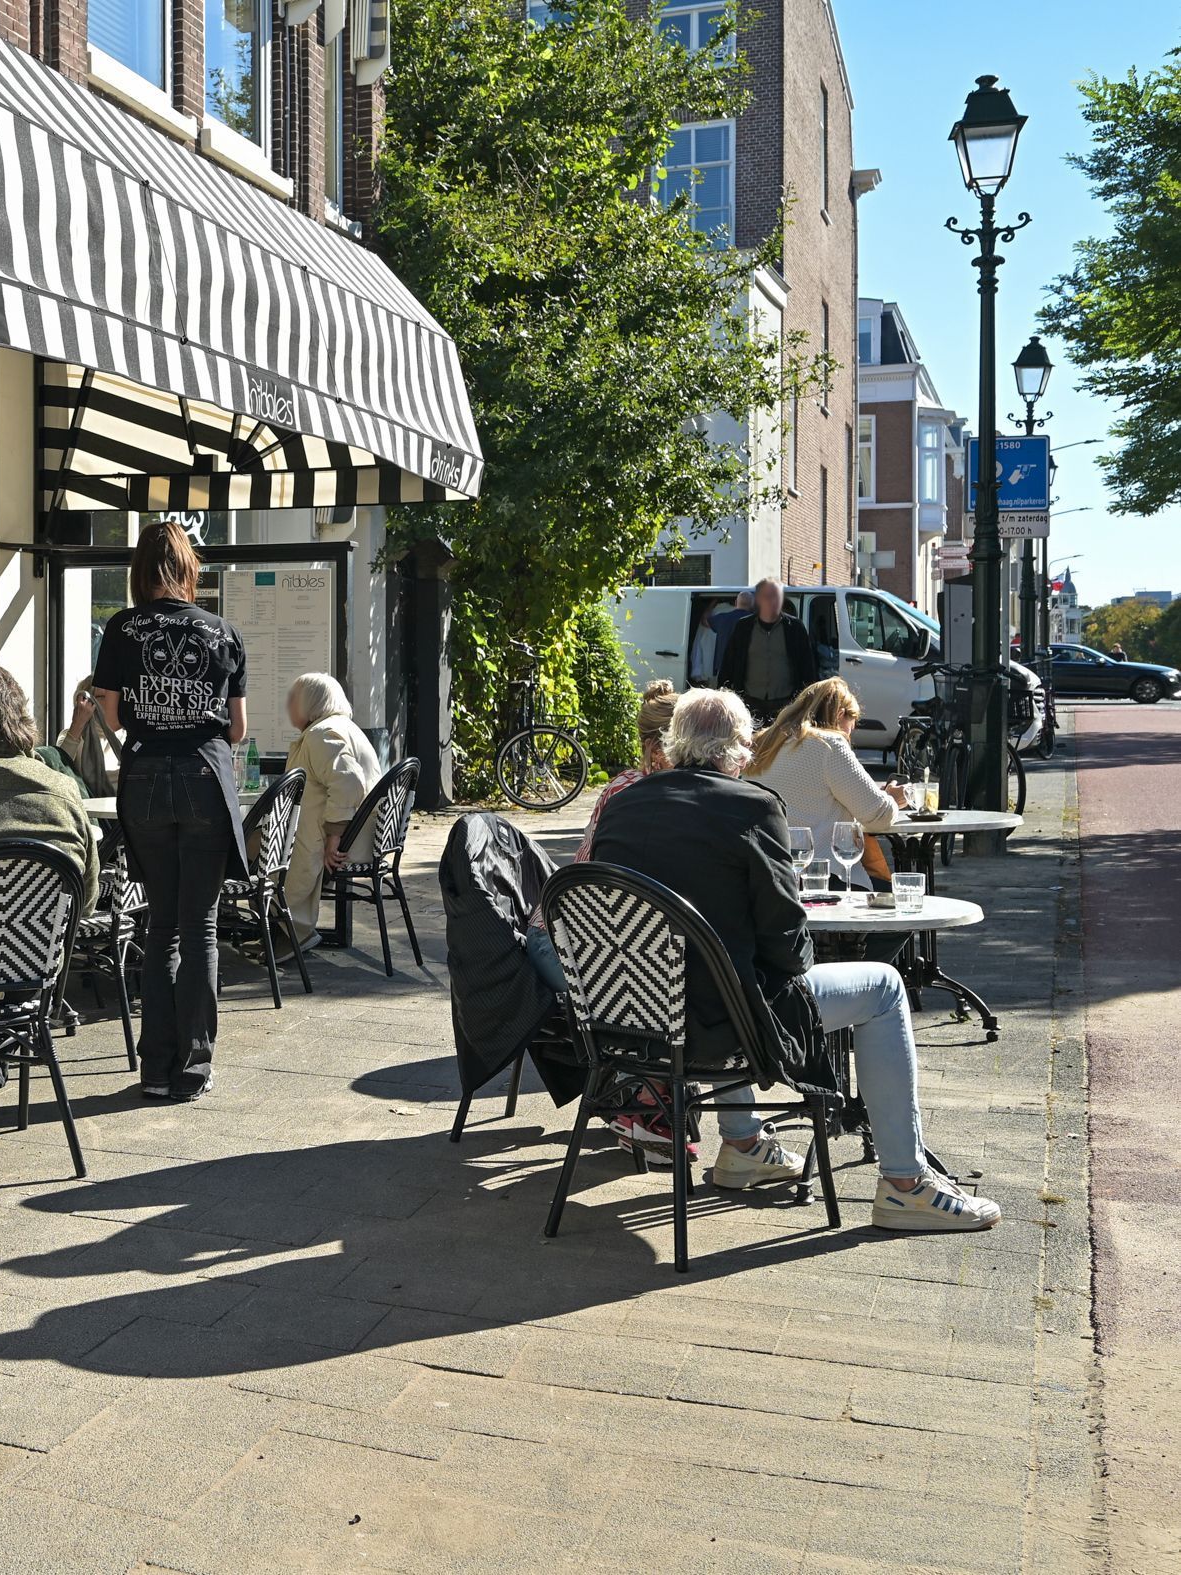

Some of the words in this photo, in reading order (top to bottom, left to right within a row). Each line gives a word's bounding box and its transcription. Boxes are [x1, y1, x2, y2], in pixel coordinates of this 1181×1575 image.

[250, 378, 293, 425] nibbles
[431, 450, 461, 488] drinks
[1002, 514, 1015, 522] t/m
[1018, 514, 1048, 523] zaterdag
[1028, 527, 1032, 535] h
[282, 573, 325, 589] nibbles
[122, 614, 153, 631] New
[154, 614, 189, 628] York
[139, 675, 214, 697] EXPRESS
[122, 687, 182, 708] TAILOR
[187, 694, 226, 712] SHOP
[134, 704, 175, 715] ALTERATIONS
[186, 709, 200, 717] ANY
[136, 712, 161, 721] EXPERT
[161, 713, 187, 721] SEWING
